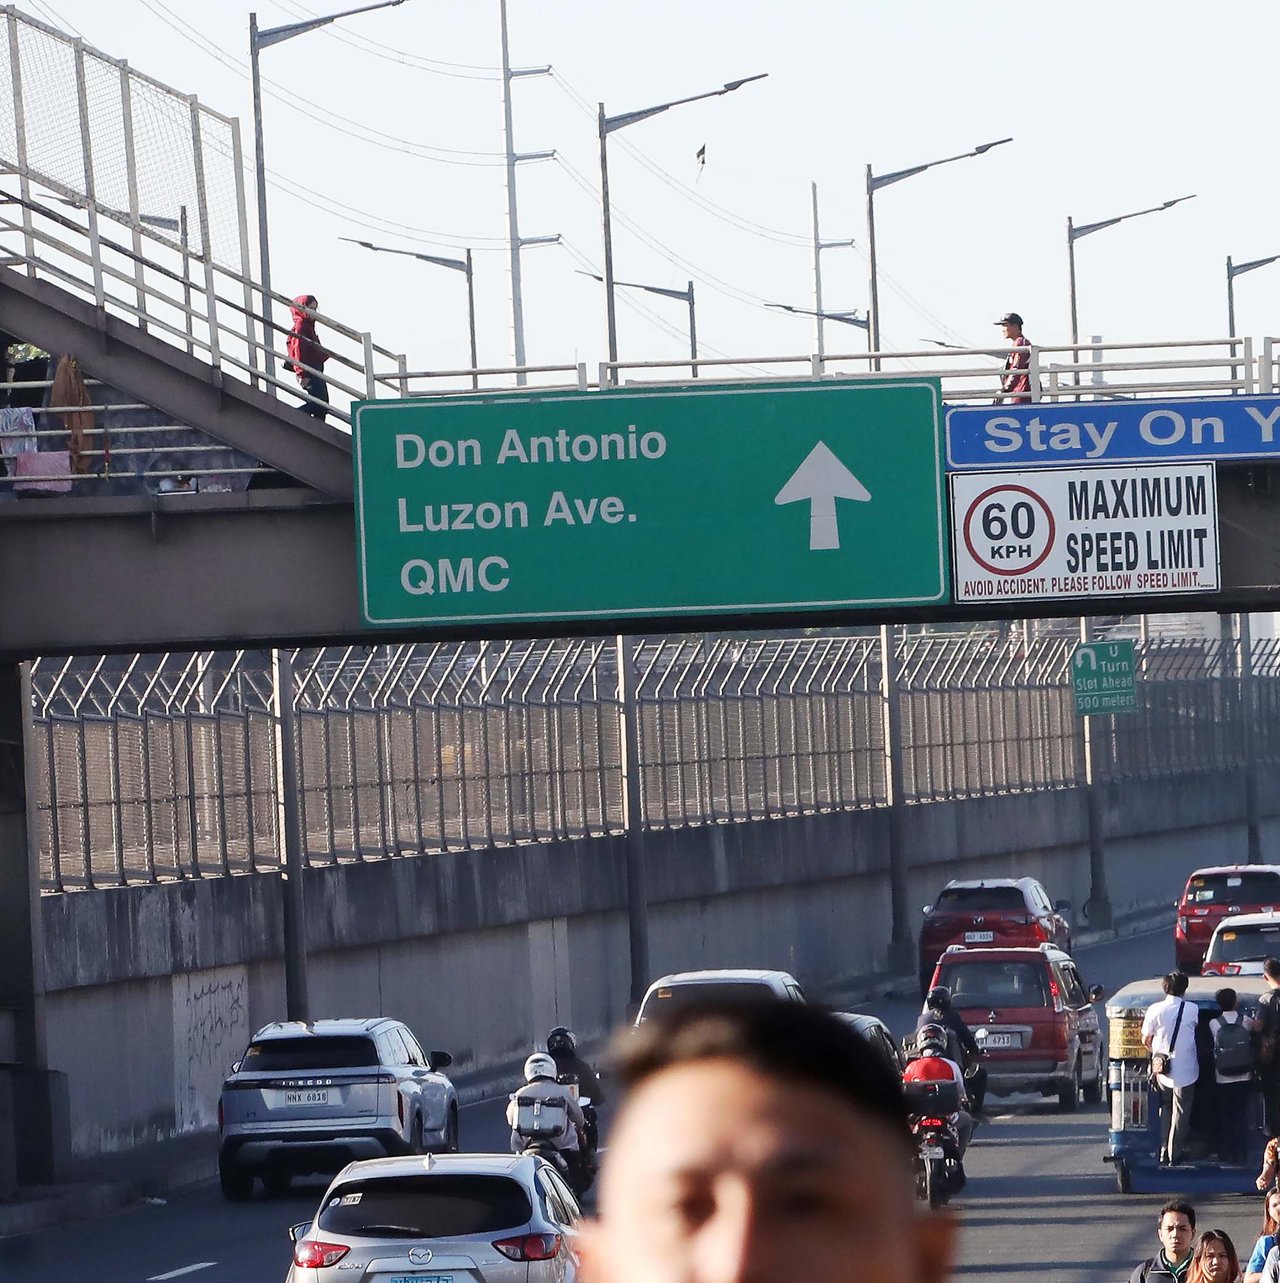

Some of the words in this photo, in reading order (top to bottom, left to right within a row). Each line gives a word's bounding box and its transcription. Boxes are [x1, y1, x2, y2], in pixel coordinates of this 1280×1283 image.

[395, 433, 482, 469] Don
[497, 424, 667, 465] Antonio
[984, 416, 1118, 458] Stay
[1139, 409, 1225, 446] On
[398, 497, 529, 532] Luzon
[543, 490, 637, 526] Ave.
[1068, 475, 1207, 521] MAXIMUM
[982, 501, 1035, 541] 60
[990, 544, 1032, 559] KPH
[1066, 531, 1139, 574] SPEED
[1146, 528, 1207, 570] LIMIT
[400, 556, 510, 595] QMC
[964, 580, 993, 596] AVOID
[996, 578, 1048, 595] ACCIDENT.
[1051, 576, 1089, 593] PLEASE
[1092, 574, 1132, 591] FOLLOW
[1137, 572, 1168, 589] SPEED
[1171, 572, 1201, 587] LIMIT.
[1100, 661, 1129, 672] Turn
[1109, 645, 1118, 657] U
[1078, 696, 1099, 709] 500
[1102, 695, 1134, 706] meters
[1102, 676, 1133, 689] Ahead
